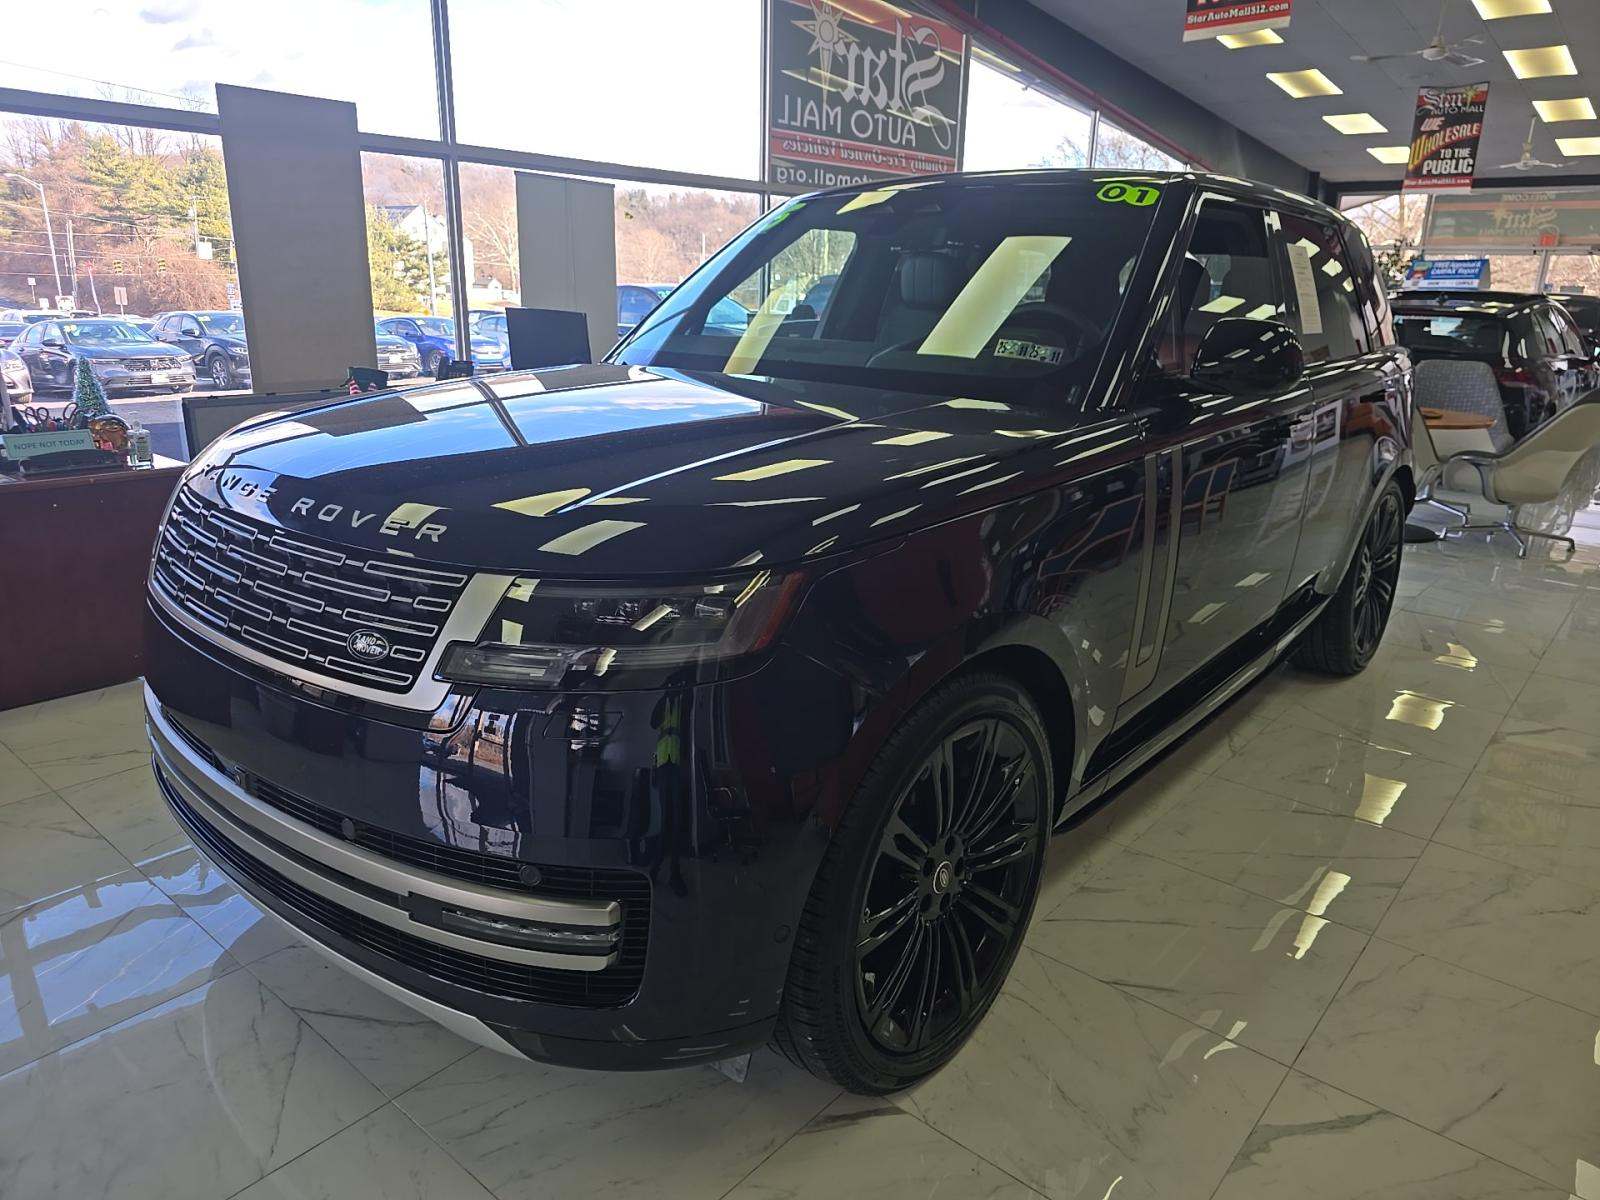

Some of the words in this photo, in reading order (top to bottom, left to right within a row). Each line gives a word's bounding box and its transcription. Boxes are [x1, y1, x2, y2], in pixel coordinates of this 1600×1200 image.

[1431, 106, 1459, 115] AUTO
[1460, 104, 1485, 113] MALL
[1421, 117, 1445, 131] WE
[1408, 123, 1480, 171] WHOLESALE
[1440, 149, 1453, 158] TO
[1455, 147, 1471, 158] THE
[1422, 158, 1474, 175] PUBLIC
[58, 439, 85, 447] TODAY
[202, 463, 278, 503] RANGE
[290, 497, 448, 543] ROVER
[354, 634, 377, 646] LAND
[353, 643, 383, 656] ROVER
